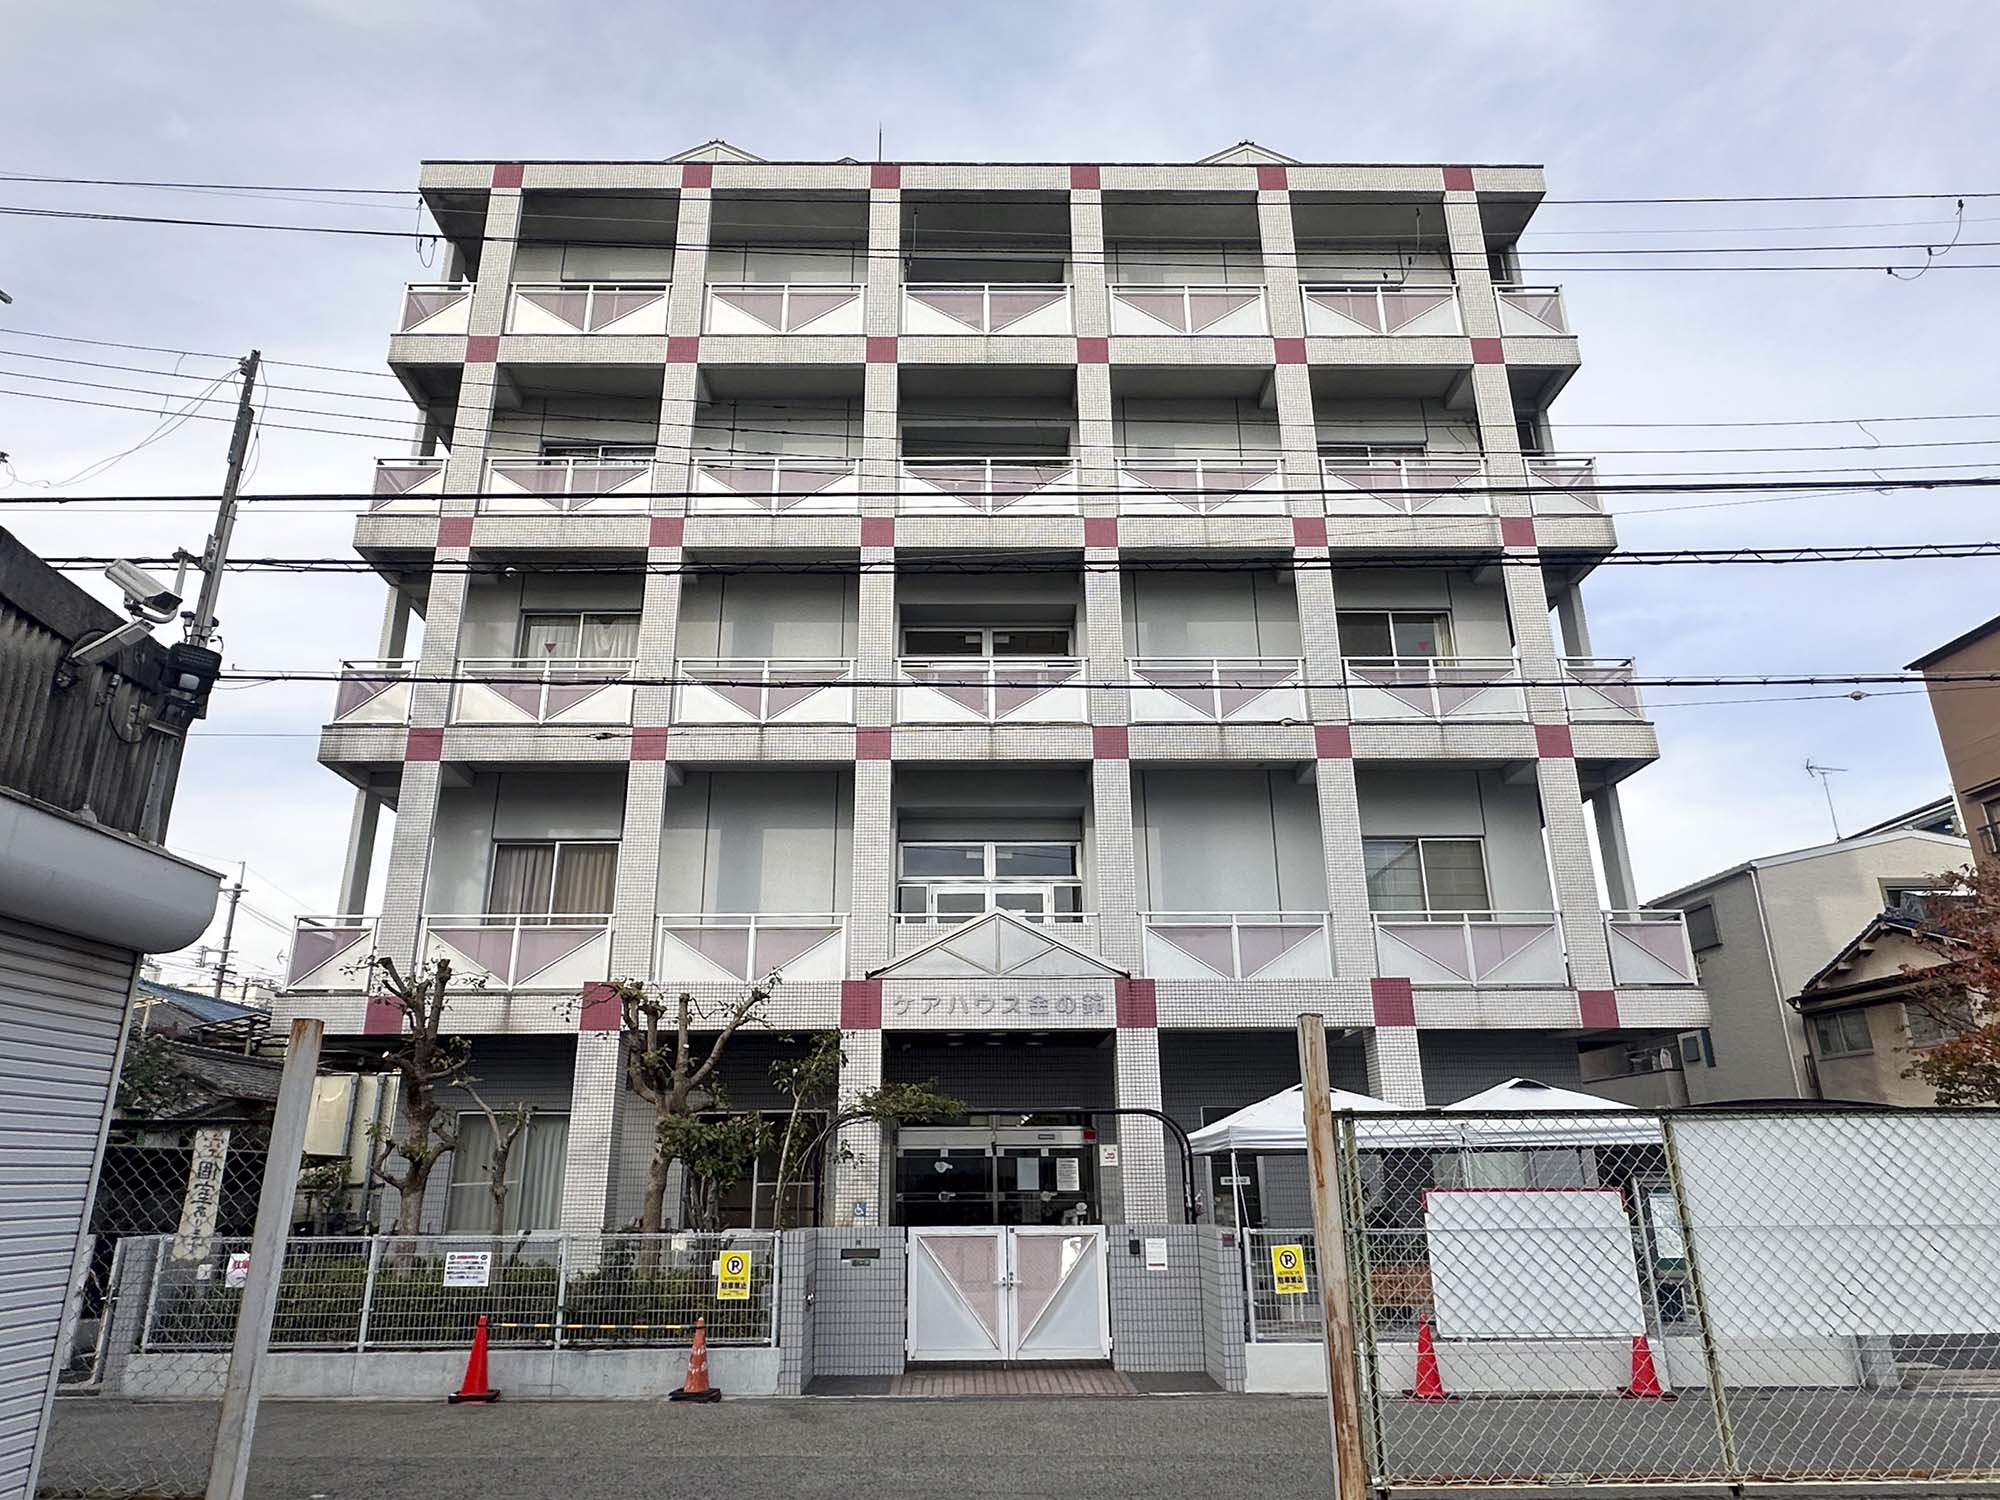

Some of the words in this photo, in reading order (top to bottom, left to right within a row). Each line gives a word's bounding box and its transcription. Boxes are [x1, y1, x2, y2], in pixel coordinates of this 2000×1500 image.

[893, 993, 1105, 1016] ケアハウス金の鈴
